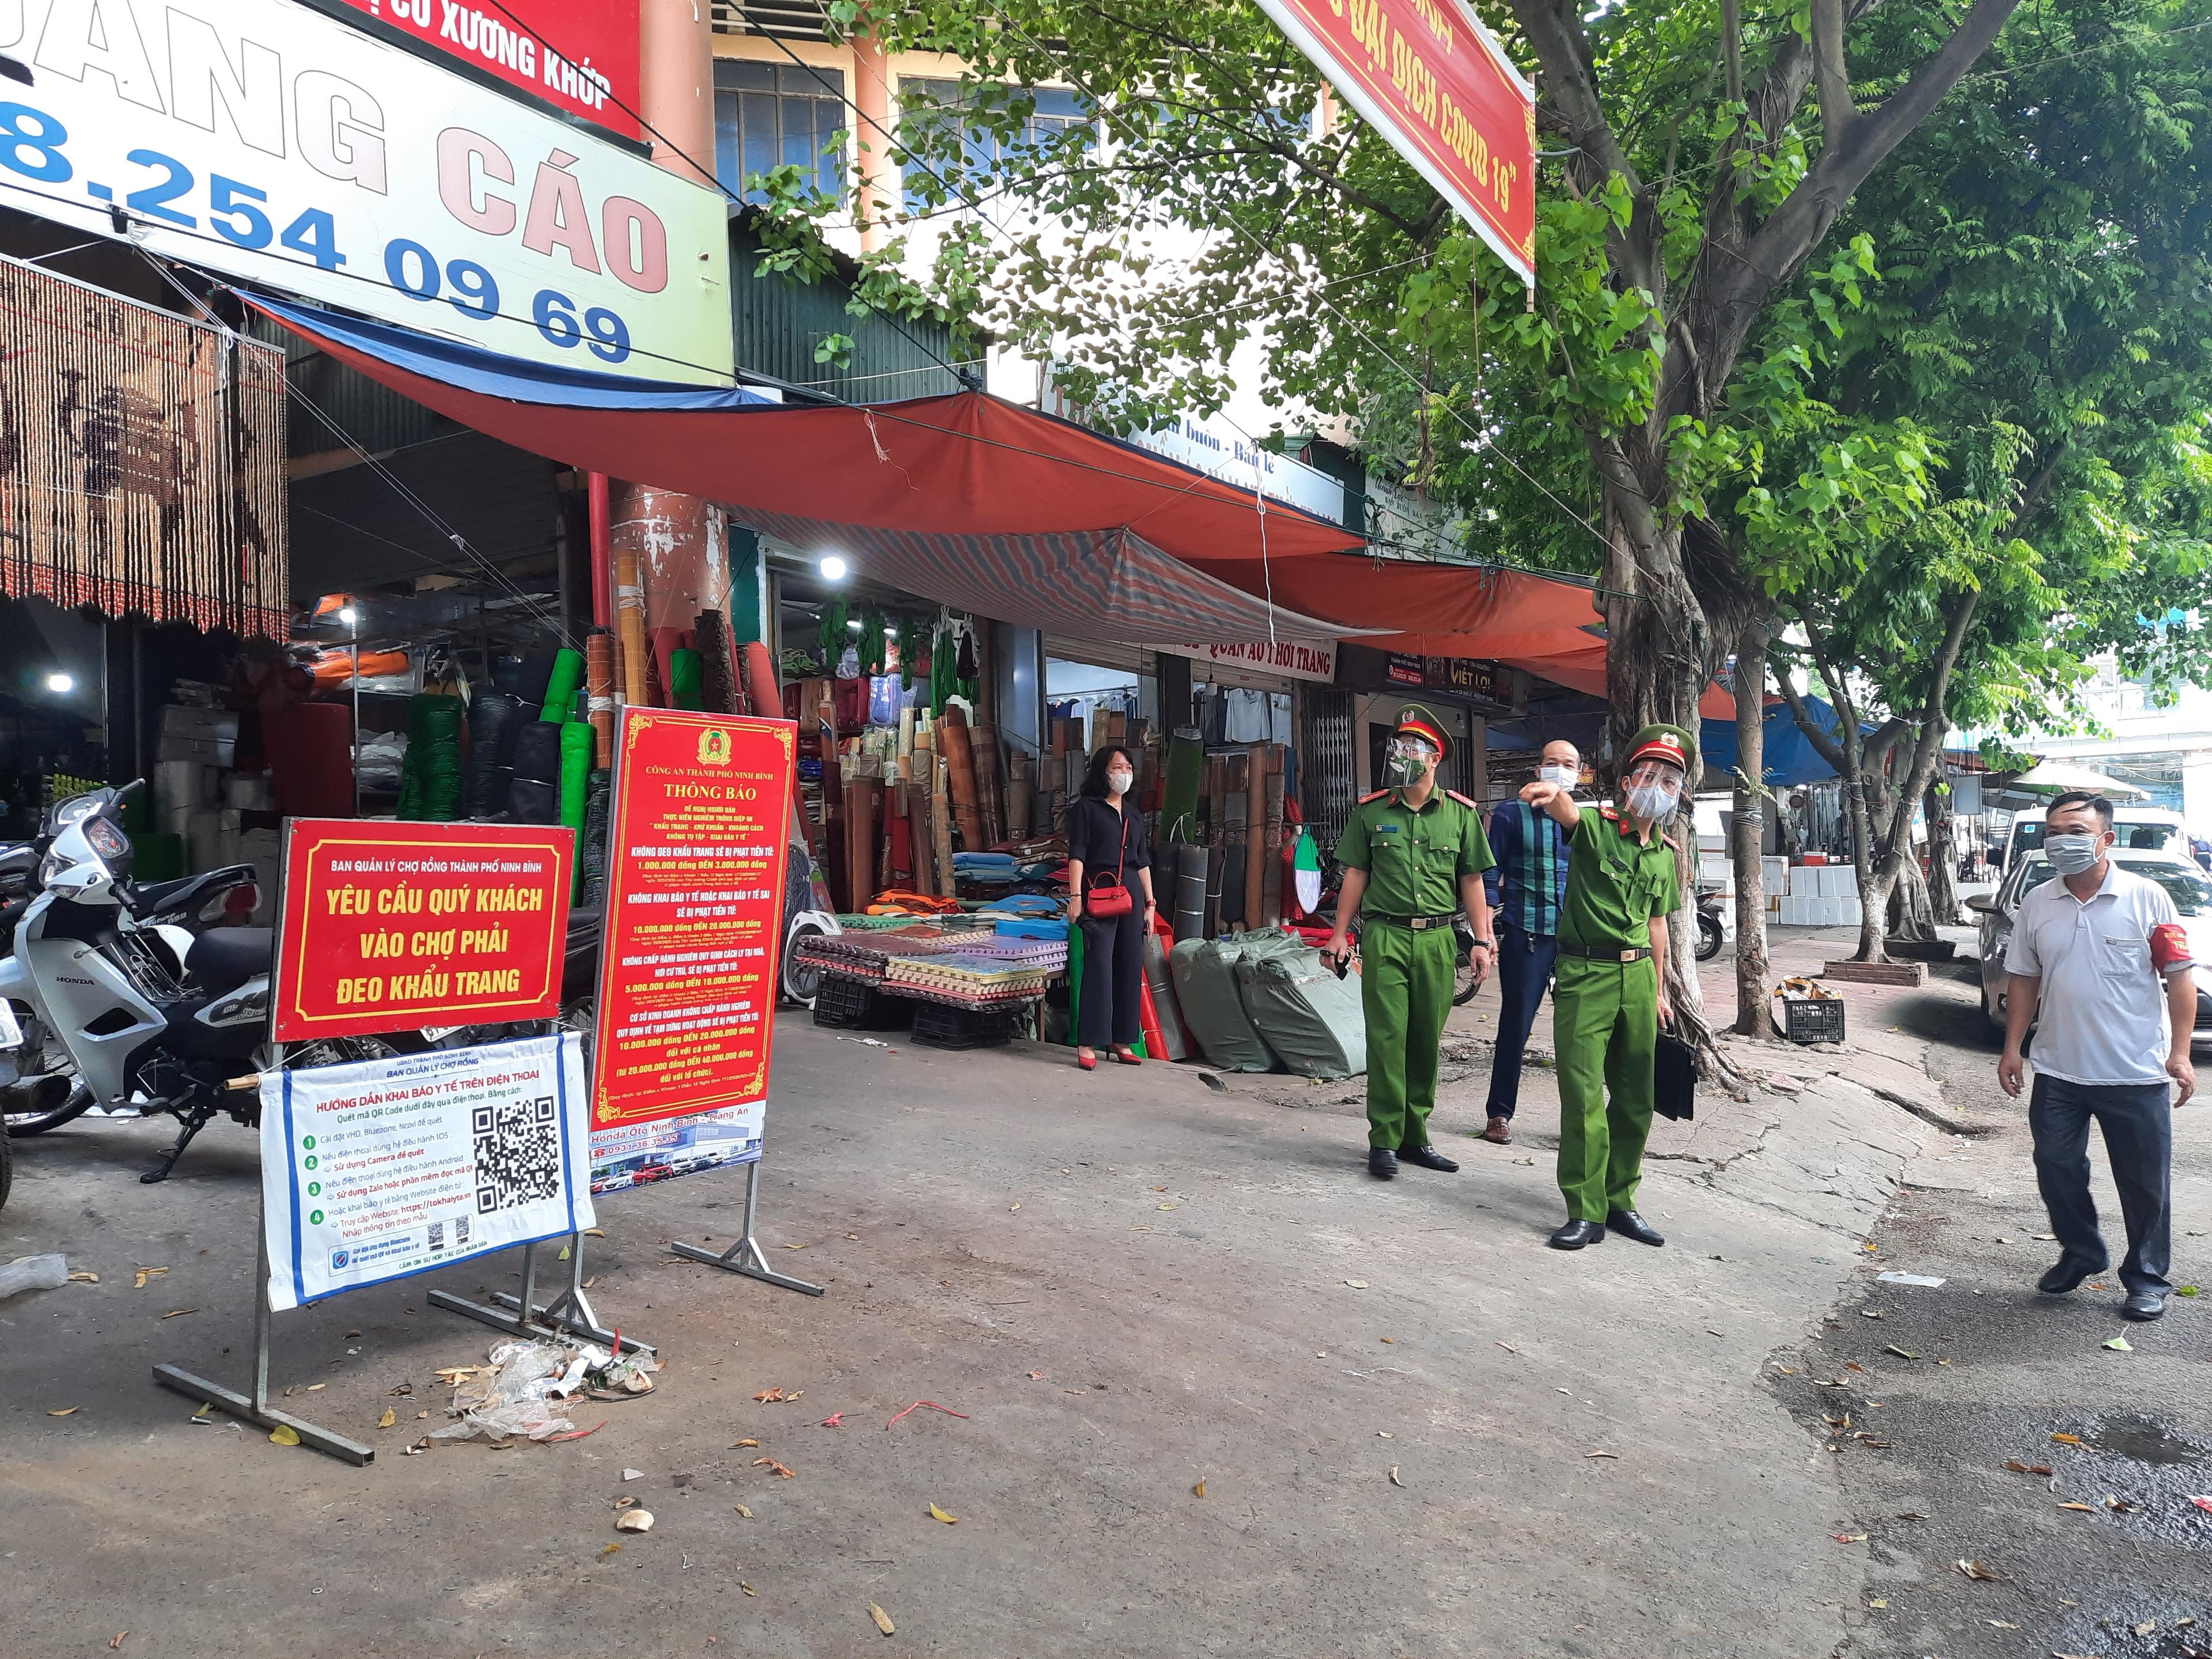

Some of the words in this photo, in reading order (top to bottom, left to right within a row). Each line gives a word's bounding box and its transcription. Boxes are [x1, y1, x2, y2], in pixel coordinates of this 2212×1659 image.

[440, 0, 536, 79] XƯƠNG
[543, 47, 611, 111] KHỚP
[1392, 28, 1436, 131] DỊCH
[1441, 92, 1488, 187] COVID
[437, 126, 668, 294] CÁO
[384, 237, 500, 321] 09
[532, 288, 631, 364] 69
[1187, 419, 1220, 452] buôn
[1297, 646, 1330, 675] TRANG
[646, 765, 671, 774] CÔNG
[673, 767, 684, 775] AN
[687, 768, 714, 777] THÀNH
[735, 771, 753, 779] NINH
[755, 771, 774, 781] BÌNH
[664, 781, 721, 799] THÔNG
[726, 784, 756, 800] BÁO
[631, 846, 656, 857] KHÔNG
[658, 847, 671, 857] ĐEO
[693, 847, 714, 857] TRANG
[638, 861, 676, 869] 1.000.000
[331, 860, 351, 872] BAN
[354, 857, 382, 873] QUẢN
[385, 859, 395, 873] LÝ
[397, 860, 419, 875] CHỢ
[421, 857, 448, 873] RỒNG
[450, 859, 479, 873] THÀNH
[481, 858, 499, 873] PHỐ
[501, 863, 521, 873] NINH
[523, 859, 541, 873] BÌNH
[326, 884, 370, 915] YÊU
[377, 880, 422, 914] CẦU
[429, 884, 469, 915] QUÝ
[476, 883, 543, 912] KHÁCH
[360, 928, 404, 959] VÀO
[411, 929, 456, 960] CHỢ
[461, 922, 508, 954] PHẢI
[56, 976, 95, 985] HONDA
[336, 976, 382, 1004] ĐEO
[389, 964, 449, 1001] KHẨU
[456, 969, 520, 995] TRANG
[387, 1070, 404, 1078] BAN
[406, 1066, 429, 1075] QUẢN
[431, 1063, 439, 1071] LÝ
[441, 1060, 456, 1070] CHỢ
[385, 1090, 409, 1102] KHAI
[412, 1086, 433, 1098] BÁO
[435, 1085, 441, 1094] Y
[444, 1078, 458, 1092] TẾ
[459, 1077, 484, 1090] TRÊN
[487, 1073, 510, 1086] ĐIỆN
[512, 1070, 539, 1082] THOẠI
[337, 1113, 355, 1124] Quét
[357, 1111, 369, 1120] mã
[372, 1108, 383, 1118] QR
[385, 1105, 403, 1115] Code
[422, 1100, 435, 1109] đây
[437, 1099, 450, 1107] qua
[453, 1096, 467, 1104] điện
[488, 1089, 506, 1098] Bằng
[346, 1130, 362, 1138] VHD,
[364, 1126, 397, 1136] Bluezone,
[399, 1120, 416, 1130] Ncovi
[427, 1116, 442, 1126] quét
[418, 1134, 435, 1143] hành
[437, 1132, 448, 1140] IOS
[591, 1131, 626, 1143] Honda
[652, 1122, 674, 1132] Ninh
[346, 1160, 366, 1168] dụng
[368, 1154, 395, 1164] Camera
[407, 1147, 425, 1158] quét
[419, 1160, 437, 1169] hành
[438, 1154, 464, 1165] Android
[349, 1188, 368, 1197] dụng
[369, 1184, 383, 1192] Zalo
[441, 1170, 454, 1178] đọc
[340, 1219, 355, 1228] Truy
[402, 1192, 471, 1213] https://tokhaiyte.vn
[348, 1202, 362, 1212] khai
[363, 1199, 378, 1208] báo
[380, 1199, 383, 1207] y
[410, 1187, 437, 1199] Website
[438, 1184, 453, 1192] điện
[396, 1217, 411, 1226] theo
